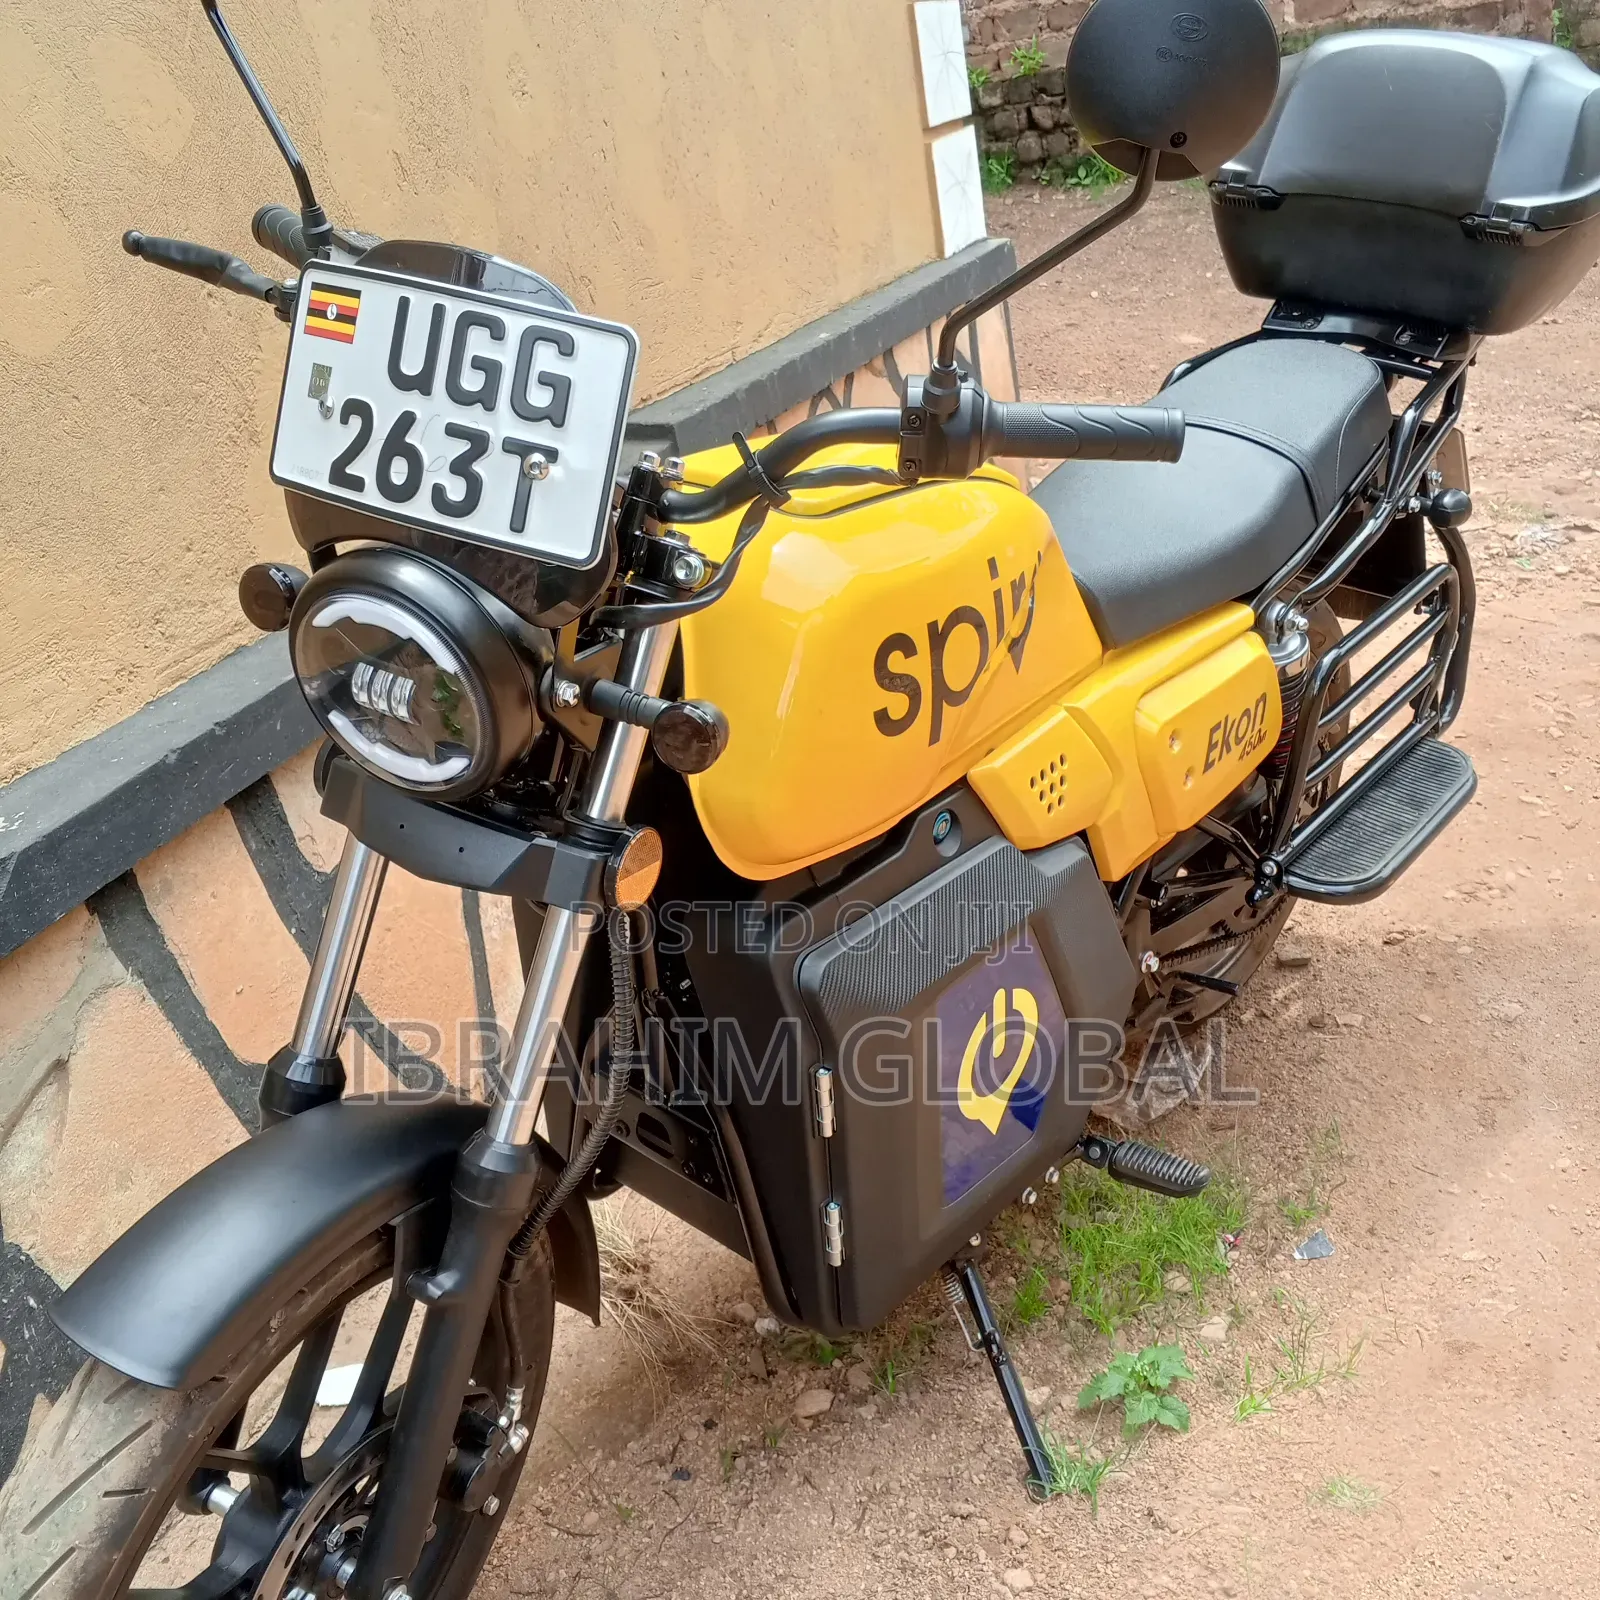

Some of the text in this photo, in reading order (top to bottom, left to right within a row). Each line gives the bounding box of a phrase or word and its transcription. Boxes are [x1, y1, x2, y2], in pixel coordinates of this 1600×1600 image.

[388, 295, 575, 428] UGG
[328, 397, 560, 534] 263T
[1202, 692, 1267, 775] Ekon
